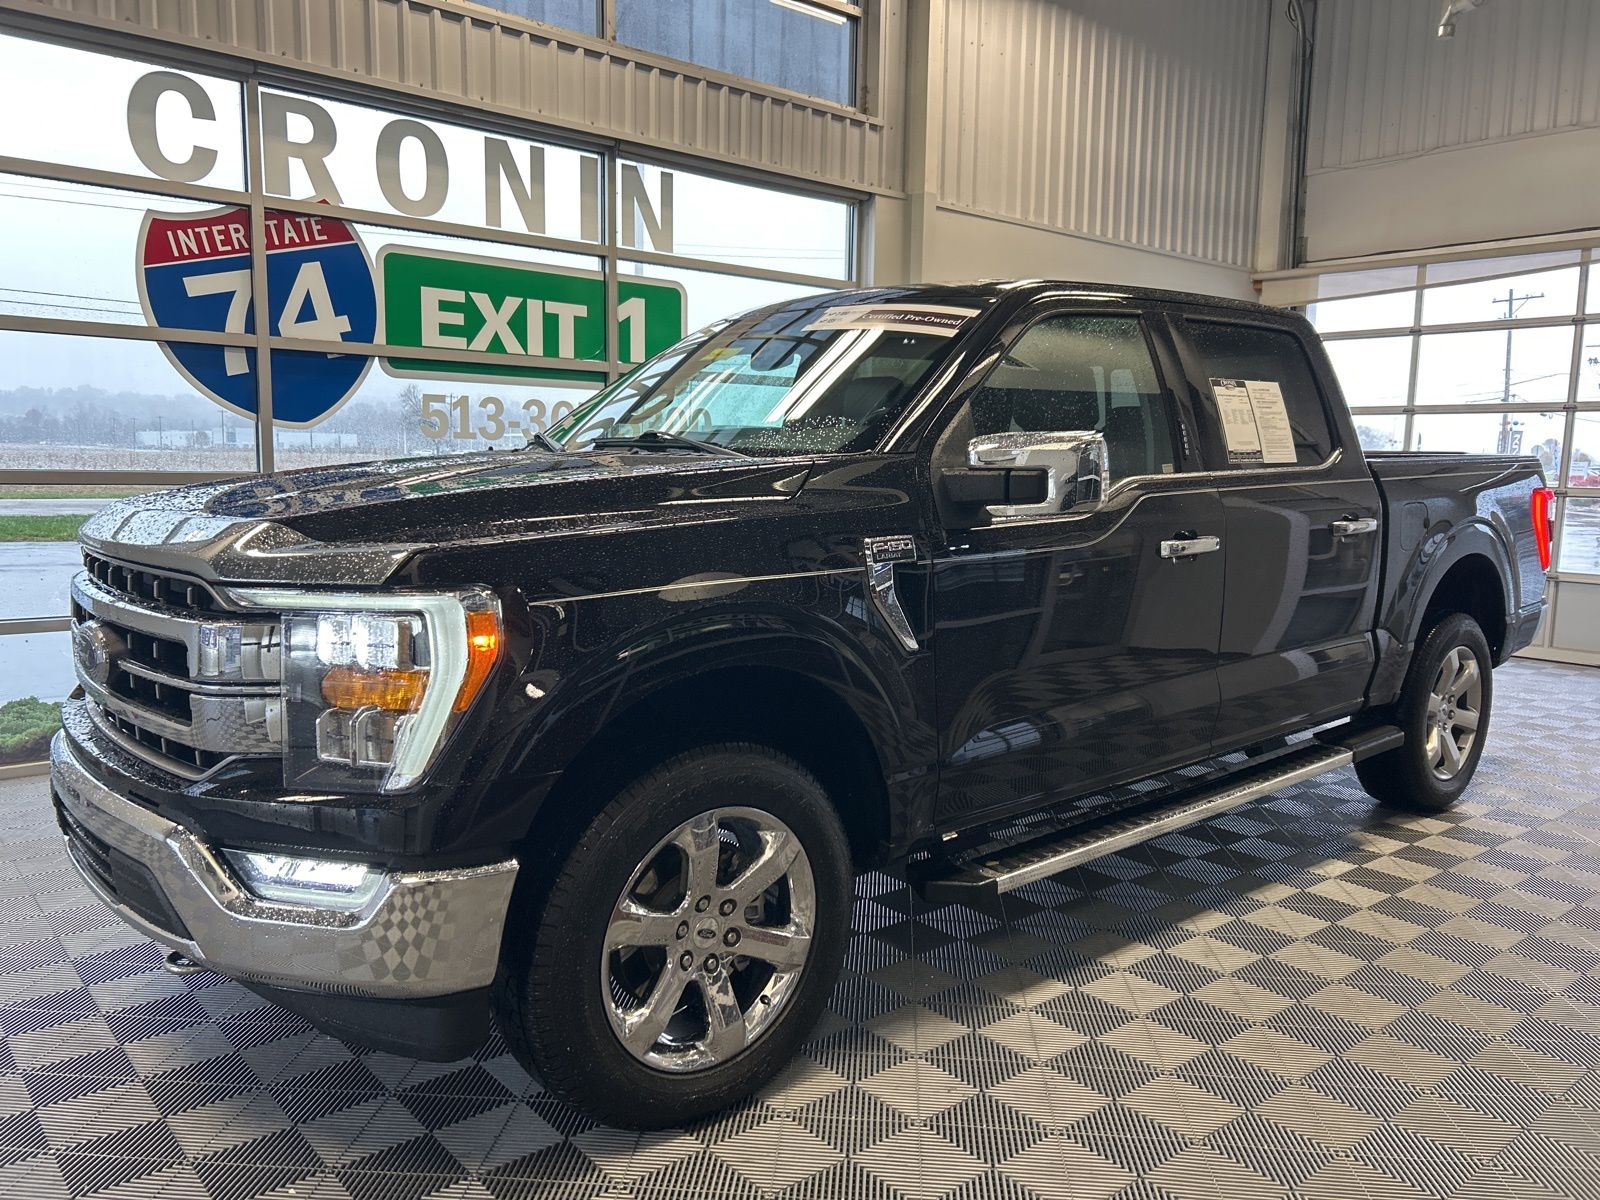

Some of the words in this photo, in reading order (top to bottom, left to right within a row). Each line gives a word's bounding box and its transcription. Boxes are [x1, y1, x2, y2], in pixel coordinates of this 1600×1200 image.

[127, 71, 673, 253] CRONIN
[167, 217, 328, 257] INTERTATE
[183, 261, 352, 377] 74
[421, 285, 588, 360] EXIT
[617, 297, 647, 363] 1
[861, 311, 903, 321] Certified
[904, 313, 962, 326] Pre-Owned
